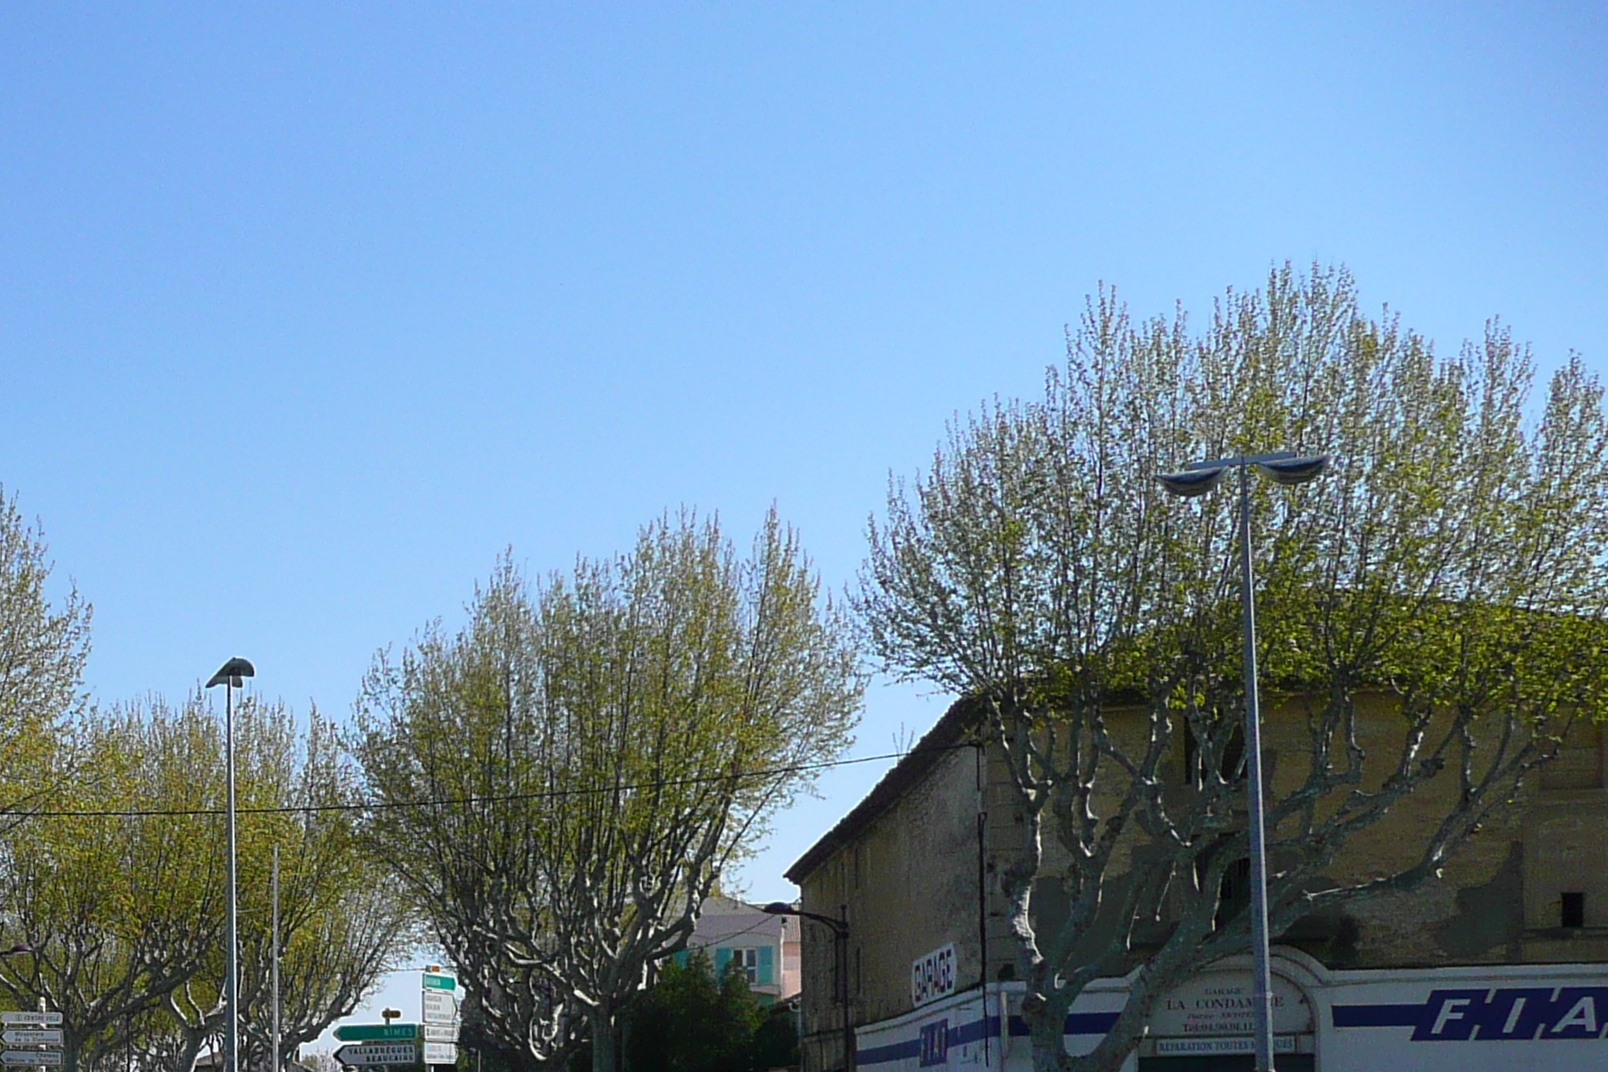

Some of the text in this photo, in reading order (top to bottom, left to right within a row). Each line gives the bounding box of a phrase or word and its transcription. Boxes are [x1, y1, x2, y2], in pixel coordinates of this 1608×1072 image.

[914, 949, 952, 1002] GARAGE
[1167, 996, 1284, 1011] LA CONDAME
[1204, 987, 1244, 996] GARAGE
[1430, 996, 1597, 1035] FIA
